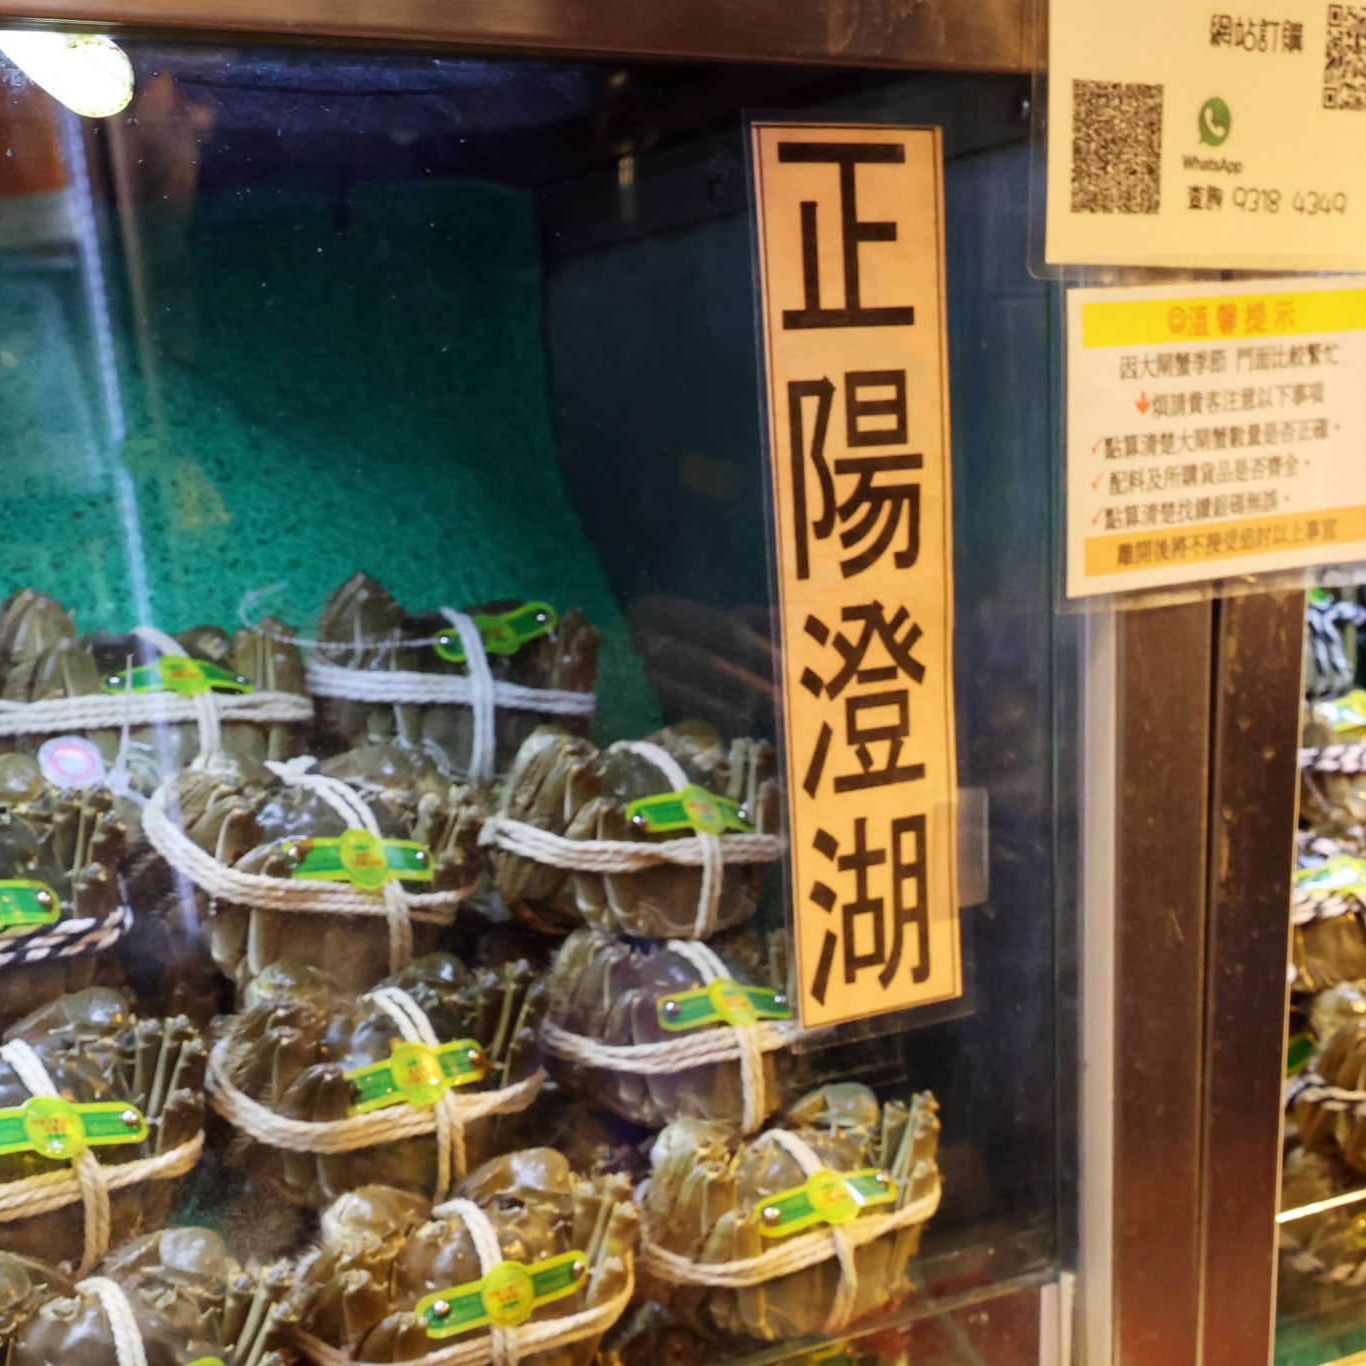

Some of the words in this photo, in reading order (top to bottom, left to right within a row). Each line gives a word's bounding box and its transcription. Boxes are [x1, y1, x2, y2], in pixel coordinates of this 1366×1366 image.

[1210, 13, 1304, 54] 網站訂購
[1181, 155, 1243, 175] WhatsApp
[776, 141, 931, 1008] 正陽澄湖
